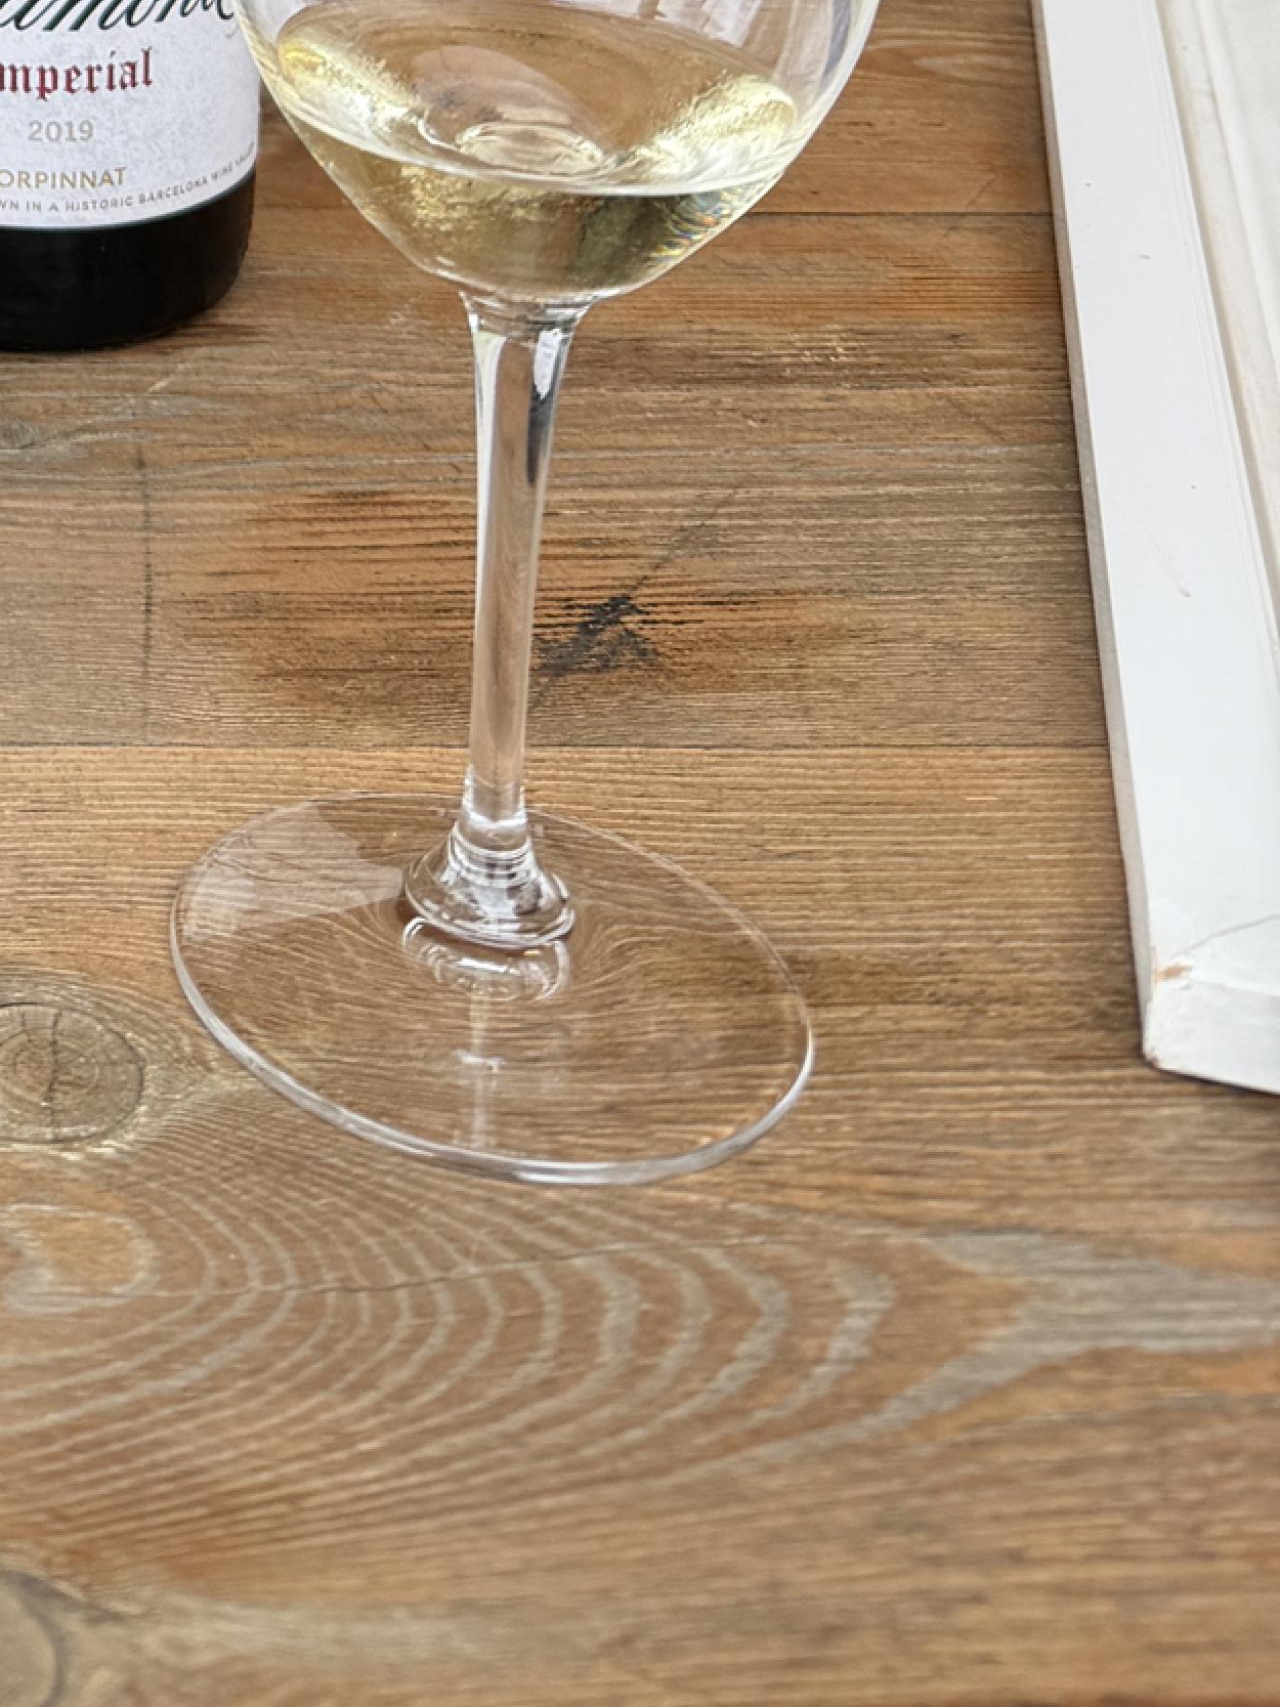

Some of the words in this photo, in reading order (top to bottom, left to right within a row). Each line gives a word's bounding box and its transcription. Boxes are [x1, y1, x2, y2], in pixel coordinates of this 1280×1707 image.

[29, 120, 93, 143] 2019
[26, 200, 42, 212] IN
[48, 201, 60, 212] A
[65, 194, 134, 213] HISTORIC
